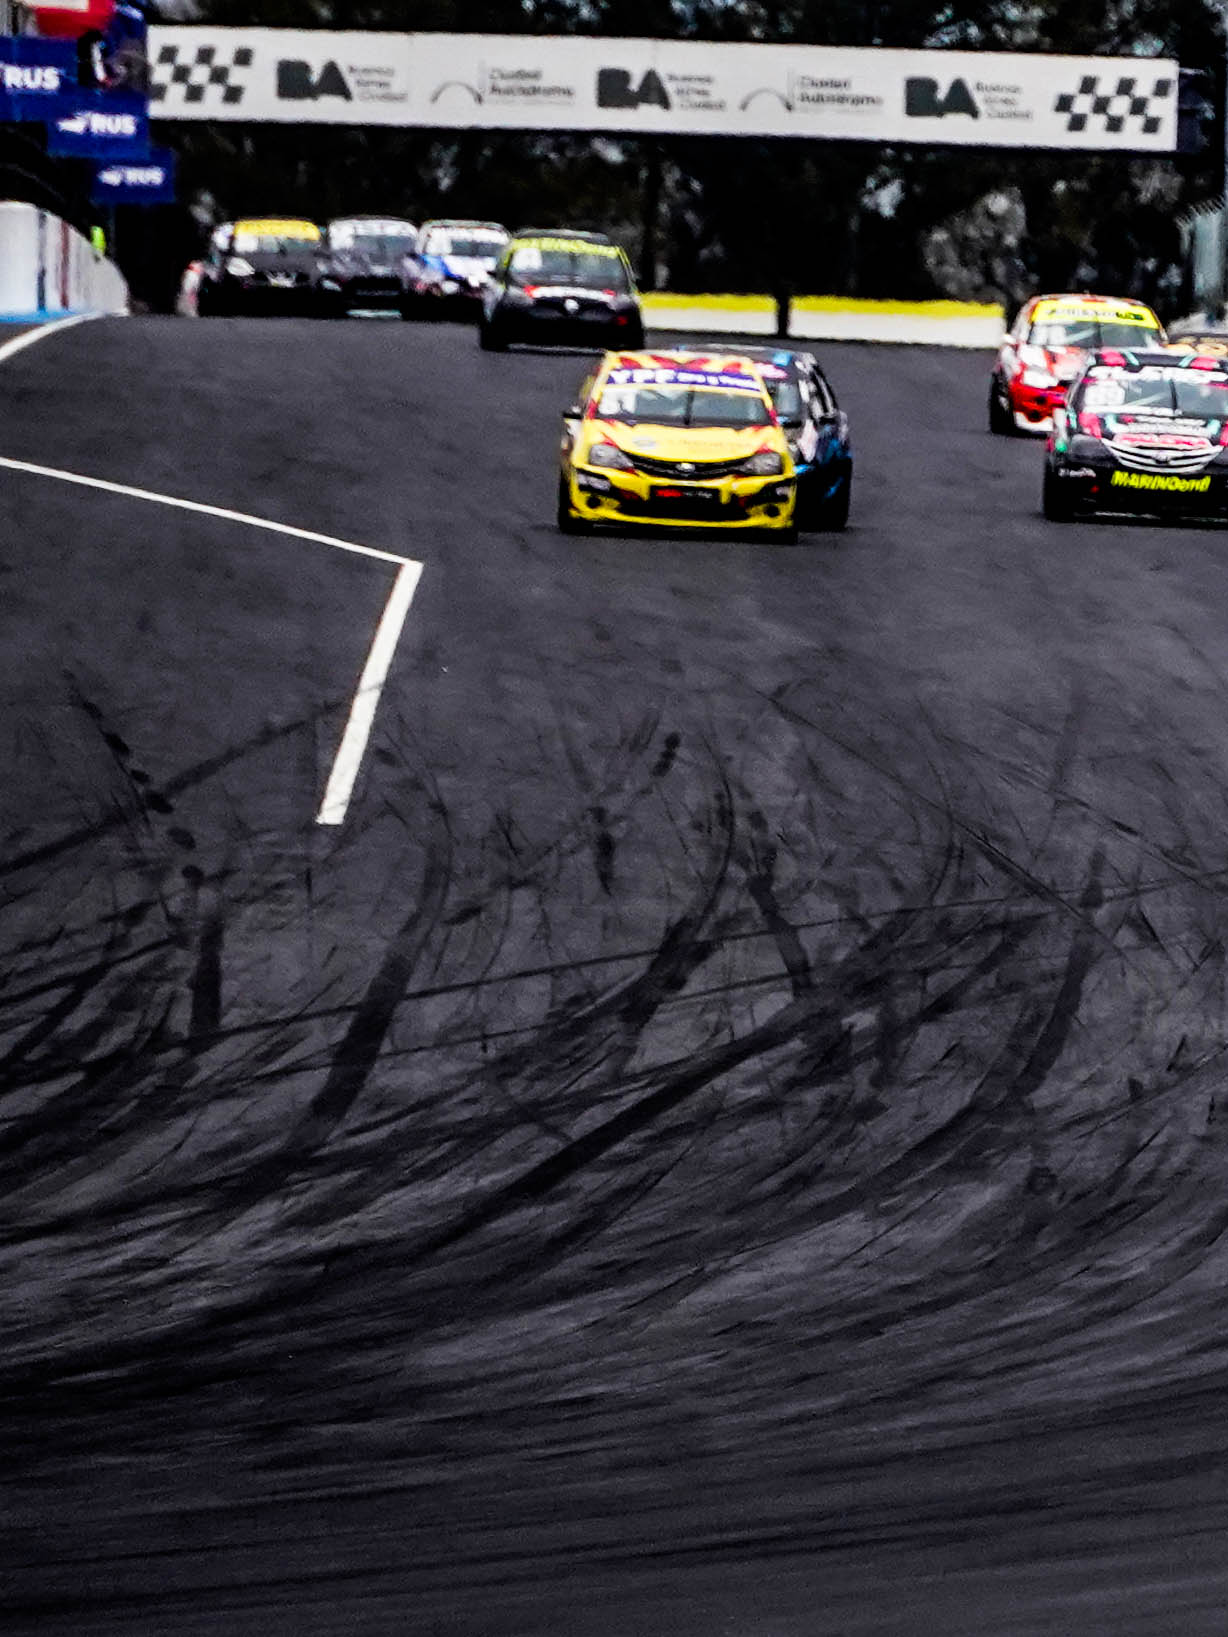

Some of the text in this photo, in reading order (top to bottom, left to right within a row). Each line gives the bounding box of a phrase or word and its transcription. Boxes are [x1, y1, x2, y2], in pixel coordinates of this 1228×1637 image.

[277, 59, 352, 102] BA
[596, 67, 672, 110] BA
[905, 76, 979, 119] BA
